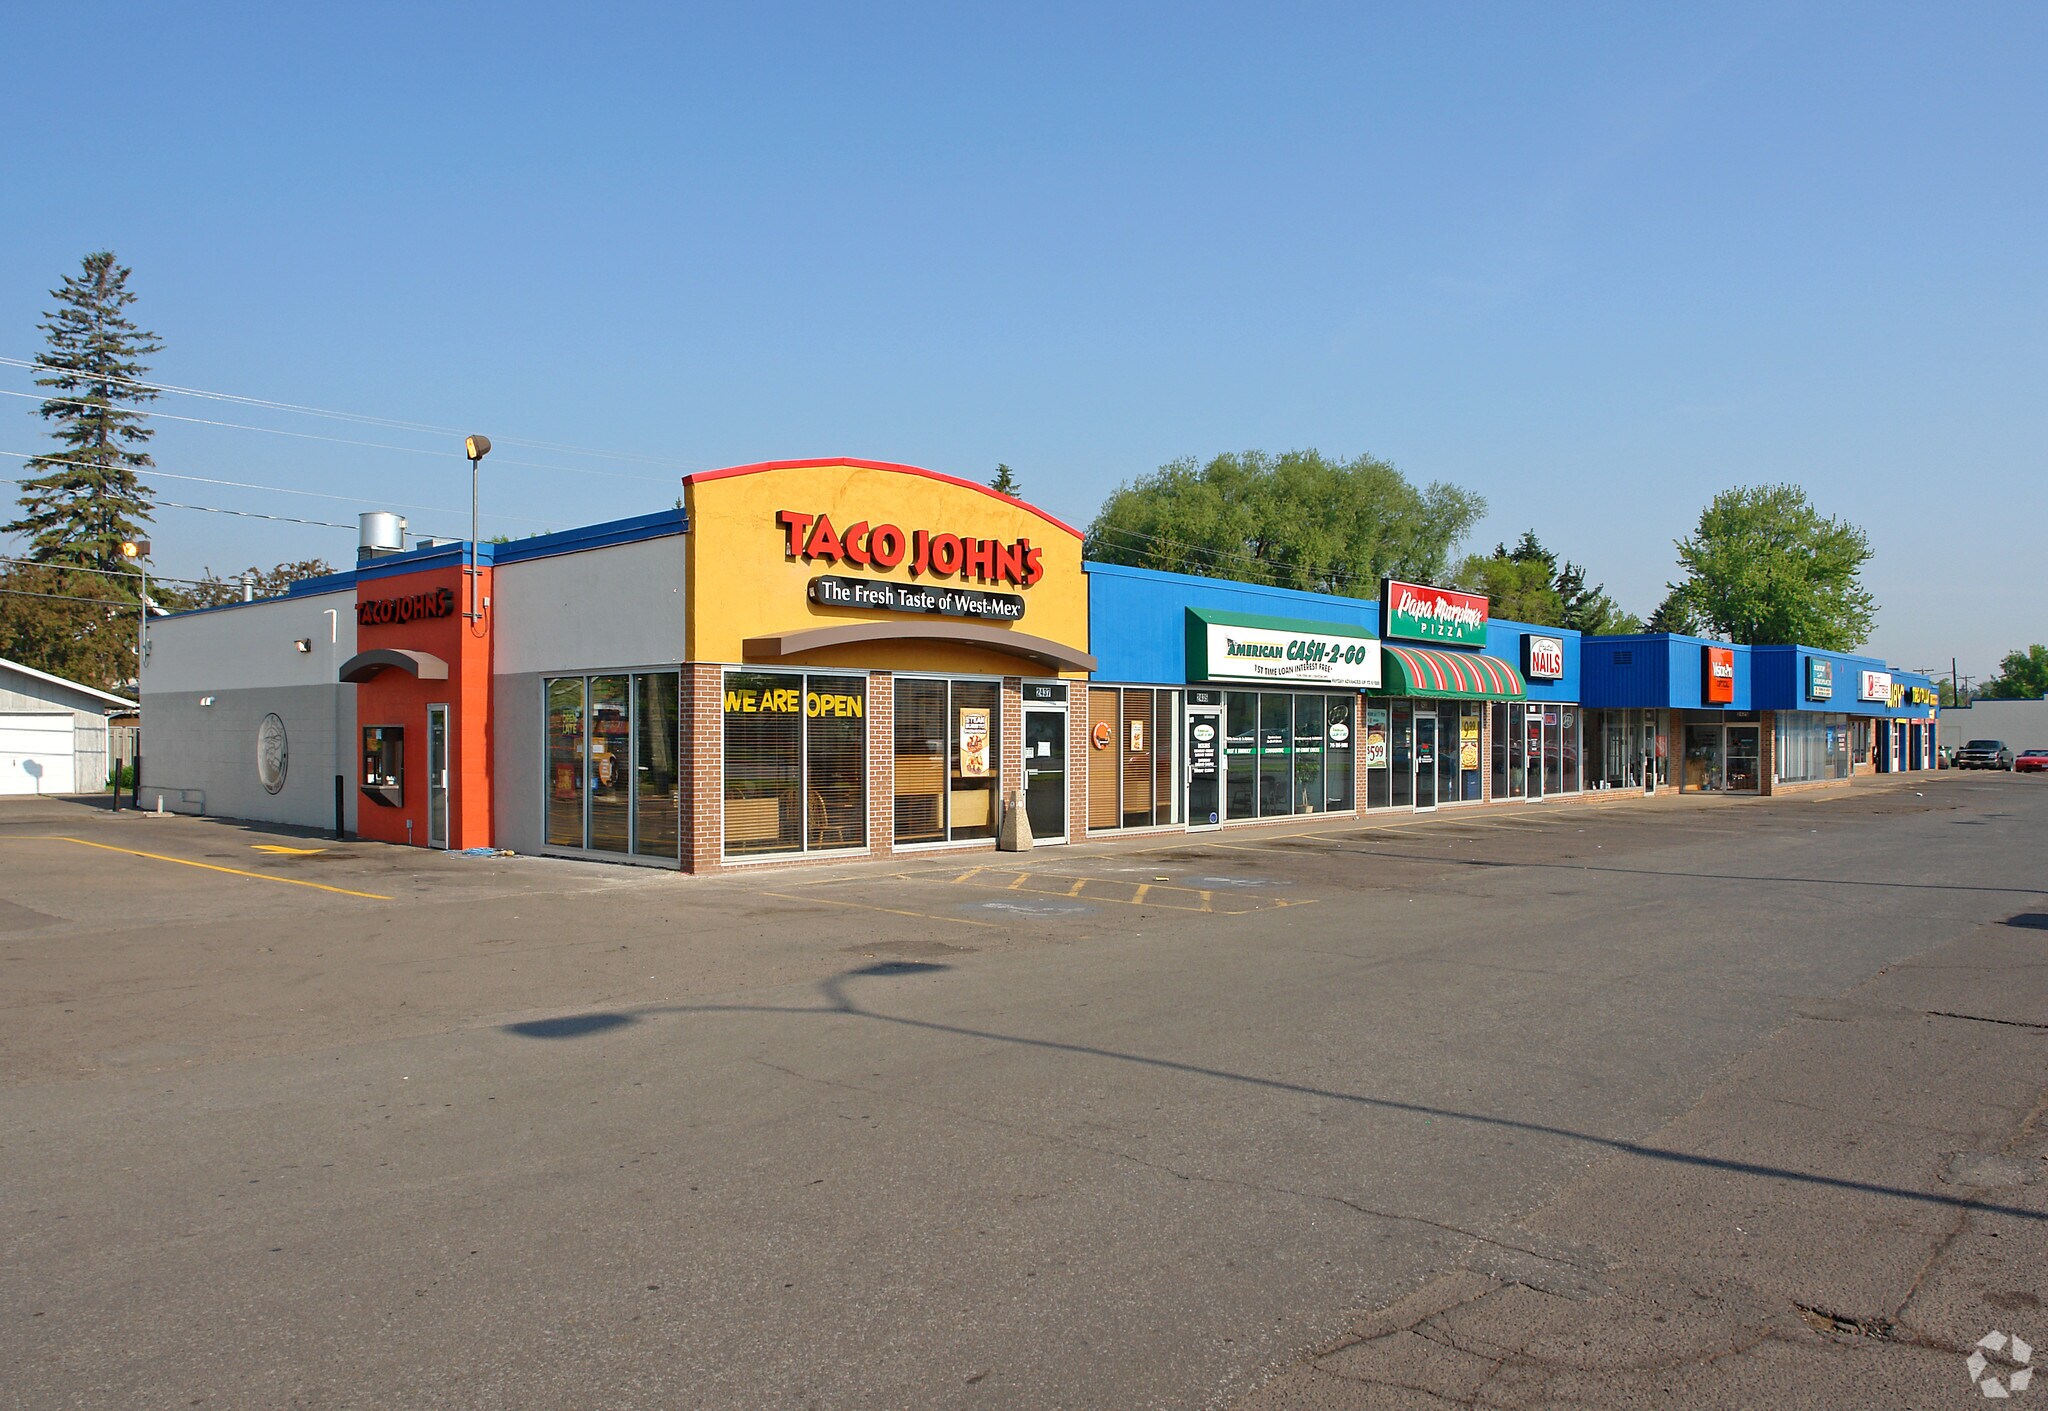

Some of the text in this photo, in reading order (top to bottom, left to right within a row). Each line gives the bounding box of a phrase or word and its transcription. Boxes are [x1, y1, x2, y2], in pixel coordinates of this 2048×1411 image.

[775, 510, 1044, 585] TACO JOHN'S
[355, 598, 393, 625] TACO
[821, 581, 1021, 617] The Fresh Taste of West-Mex
[1397, 589, 1433, 622] Papa
[1421, 622, 1463, 638] PIZZA
[1227, 642, 1284, 659] AMERICAN
[1532, 651, 1561, 674] NAILS
[1254, 664, 1264, 675] 1ST
[1264, 667, 1278, 676] TIME
[1278, 665, 1294, 676] LOAN
[1294, 662, 1318, 673] INTEREST
[723, 688, 863, 718] WE ARE OPEN
[1036, 687, 1051, 698] 2437
